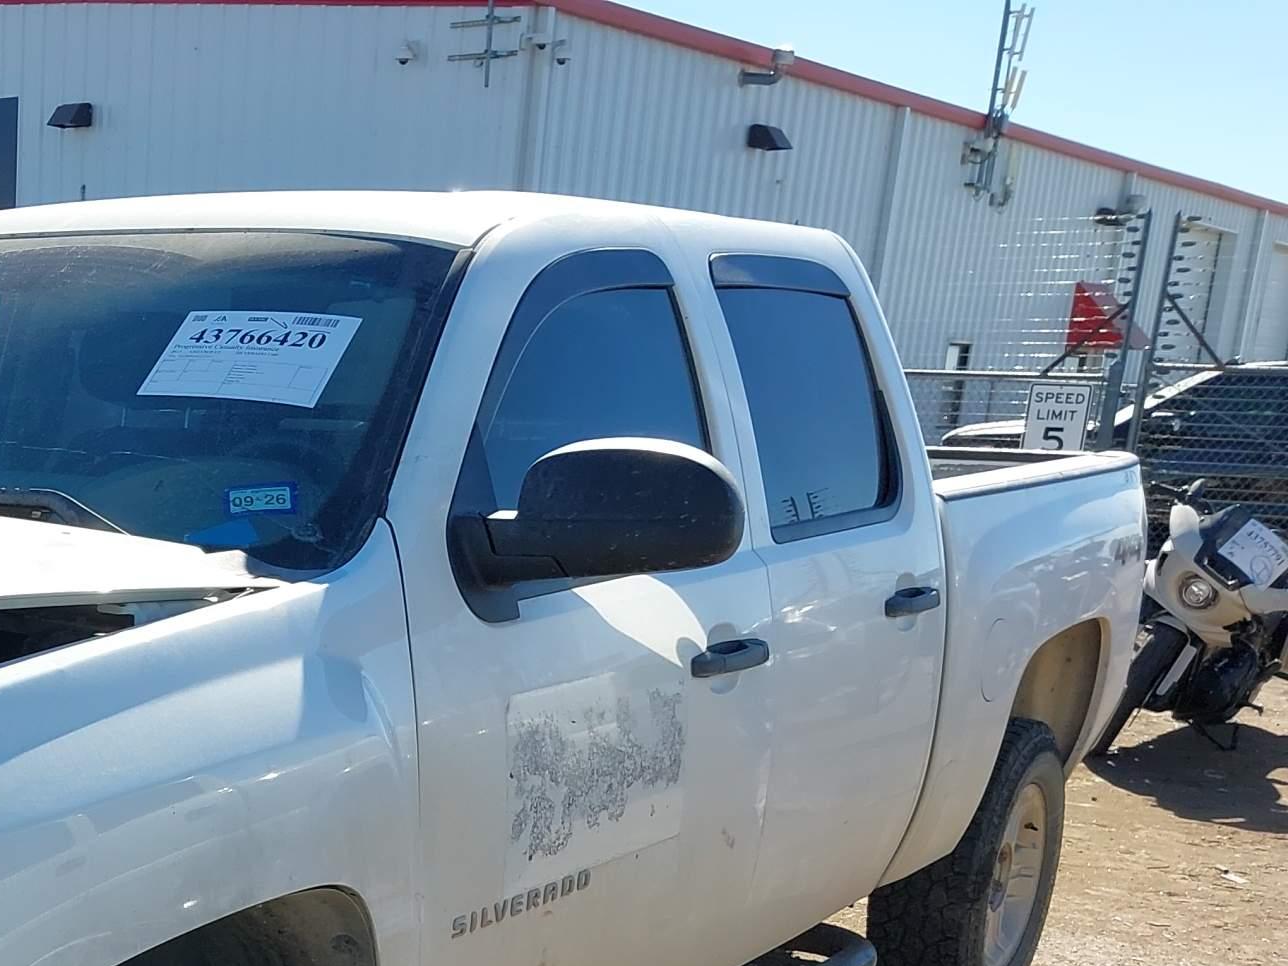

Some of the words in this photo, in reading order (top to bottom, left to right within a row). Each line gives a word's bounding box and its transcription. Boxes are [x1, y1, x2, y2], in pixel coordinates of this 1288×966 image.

[189, 328, 328, 350] 43766420
[1034, 392, 1085, 404] SPEED
[1036, 409, 1078, 421] LIMIT
[1042, 427, 1064, 450] 5
[451, 868, 592, 940] SILVERADO
